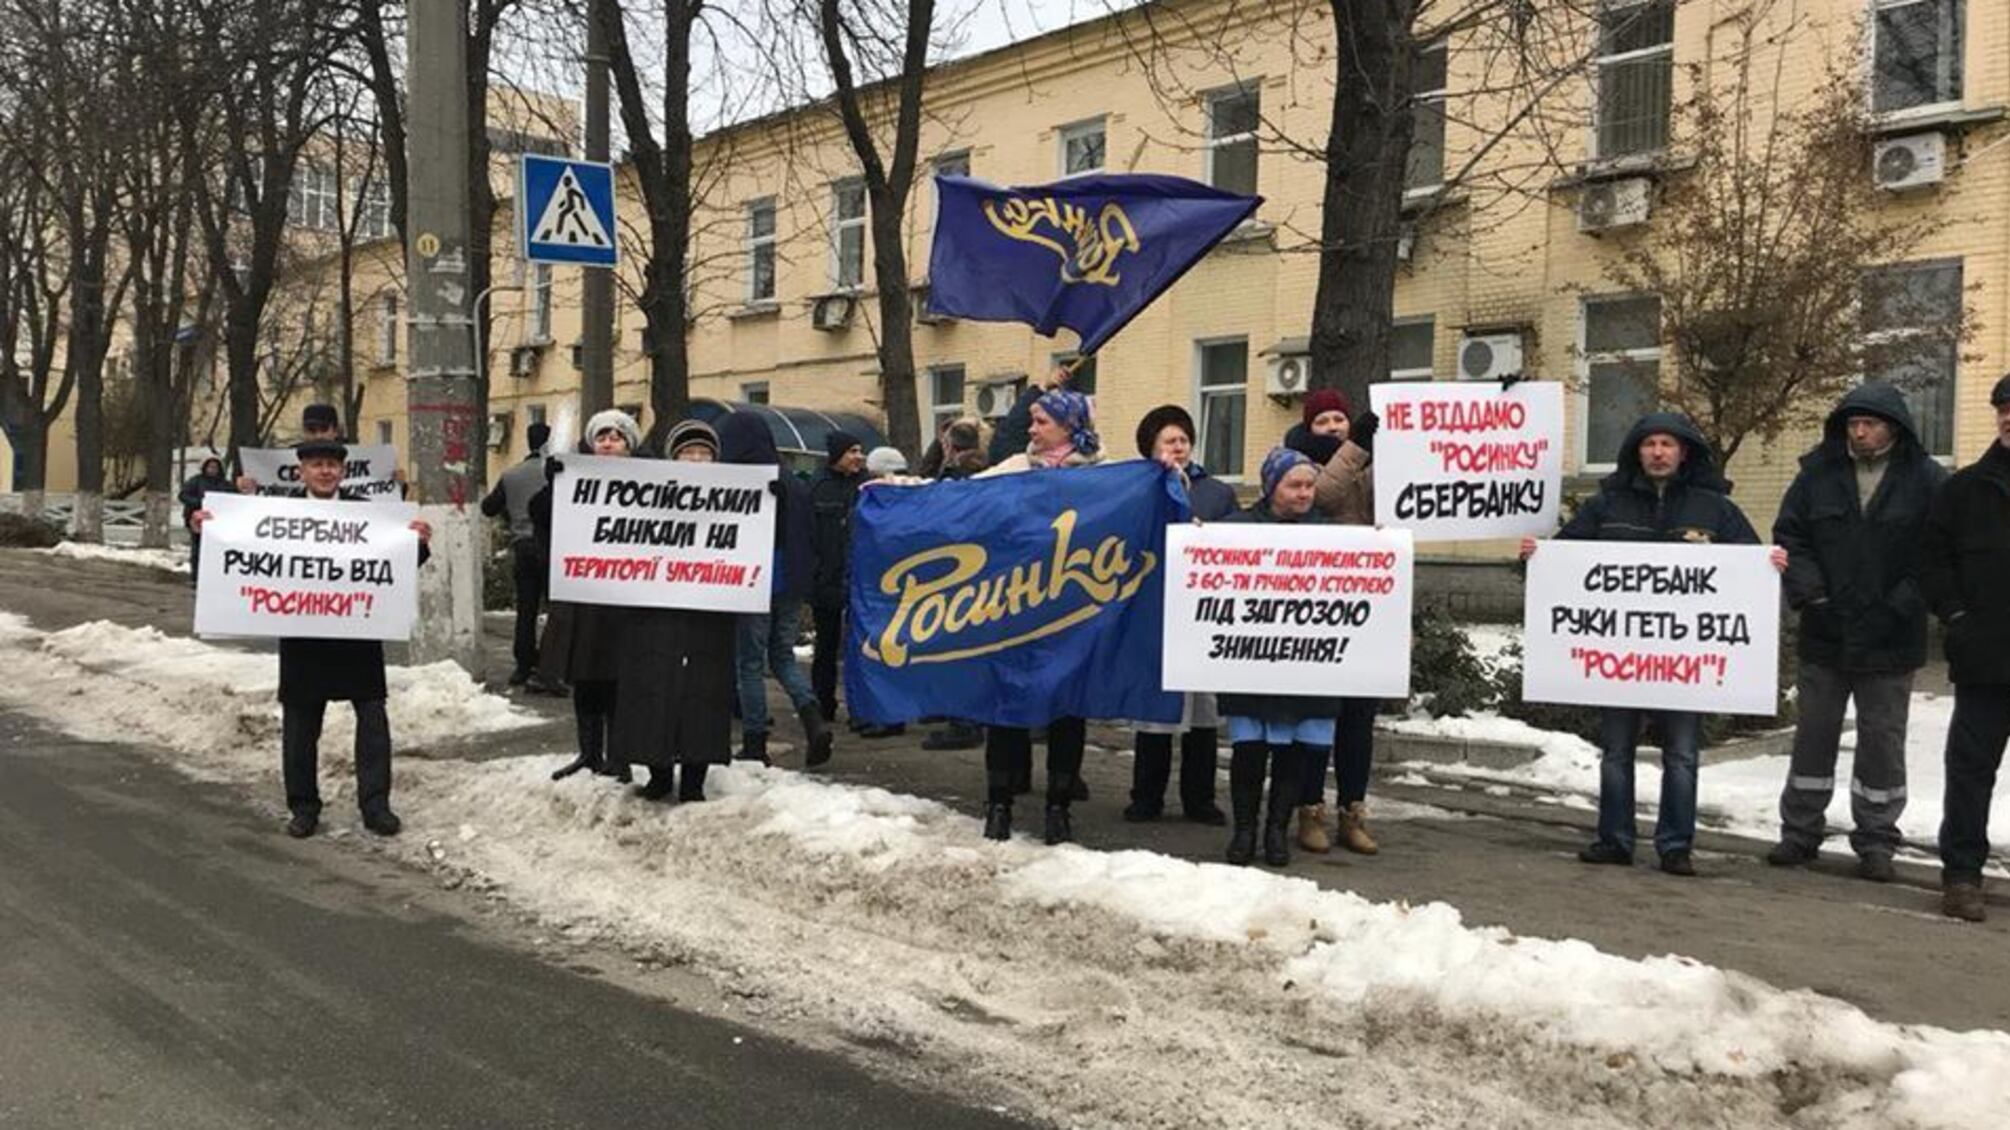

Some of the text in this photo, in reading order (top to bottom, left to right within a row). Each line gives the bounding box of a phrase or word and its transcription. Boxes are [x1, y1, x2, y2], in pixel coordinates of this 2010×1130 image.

[1387, 401, 1525, 433] НЕ ВІДДАМО
[1431, 440, 1548, 473] "РОСИНКУ"
[573, 479, 762, 515] НІ РОСІЙСЬКИМ
[1396, 479, 1544, 519] СБЕРБАНКУ
[256, 517, 368, 544] СБЕРБАНК
[593, 517, 738, 549] БАНКАМ НА
[224, 550, 393, 586] РУКИ ГЕТЬ ВІД
[564, 557, 662, 580] ТЕРИТОРІЇ
[1183, 547, 1395, 570] "РОСИНКА" ПІДПРИЄМСТВО
[870, 508, 1145, 668] Росинка
[1201, 572, 1251, 590] 60-ТИ
[1254, 574, 1316, 592] РІЧНОЮ
[1320, 576, 1394, 594] ІСТОРІЄЮ
[1584, 564, 1716, 594] СБЕРБАНК
[242, 587, 373, 617] "РОСИНКИ"!
[1196, 597, 1370, 626] ПІД ЗАГРОЗОЮ
[1552, 607, 1750, 645] РУКИ ГЕТЬ ВІД
[1209, 635, 1349, 663] ЗНИЩЕННЯ!
[1572, 648, 1726, 685] "РОСИНКИ"!
